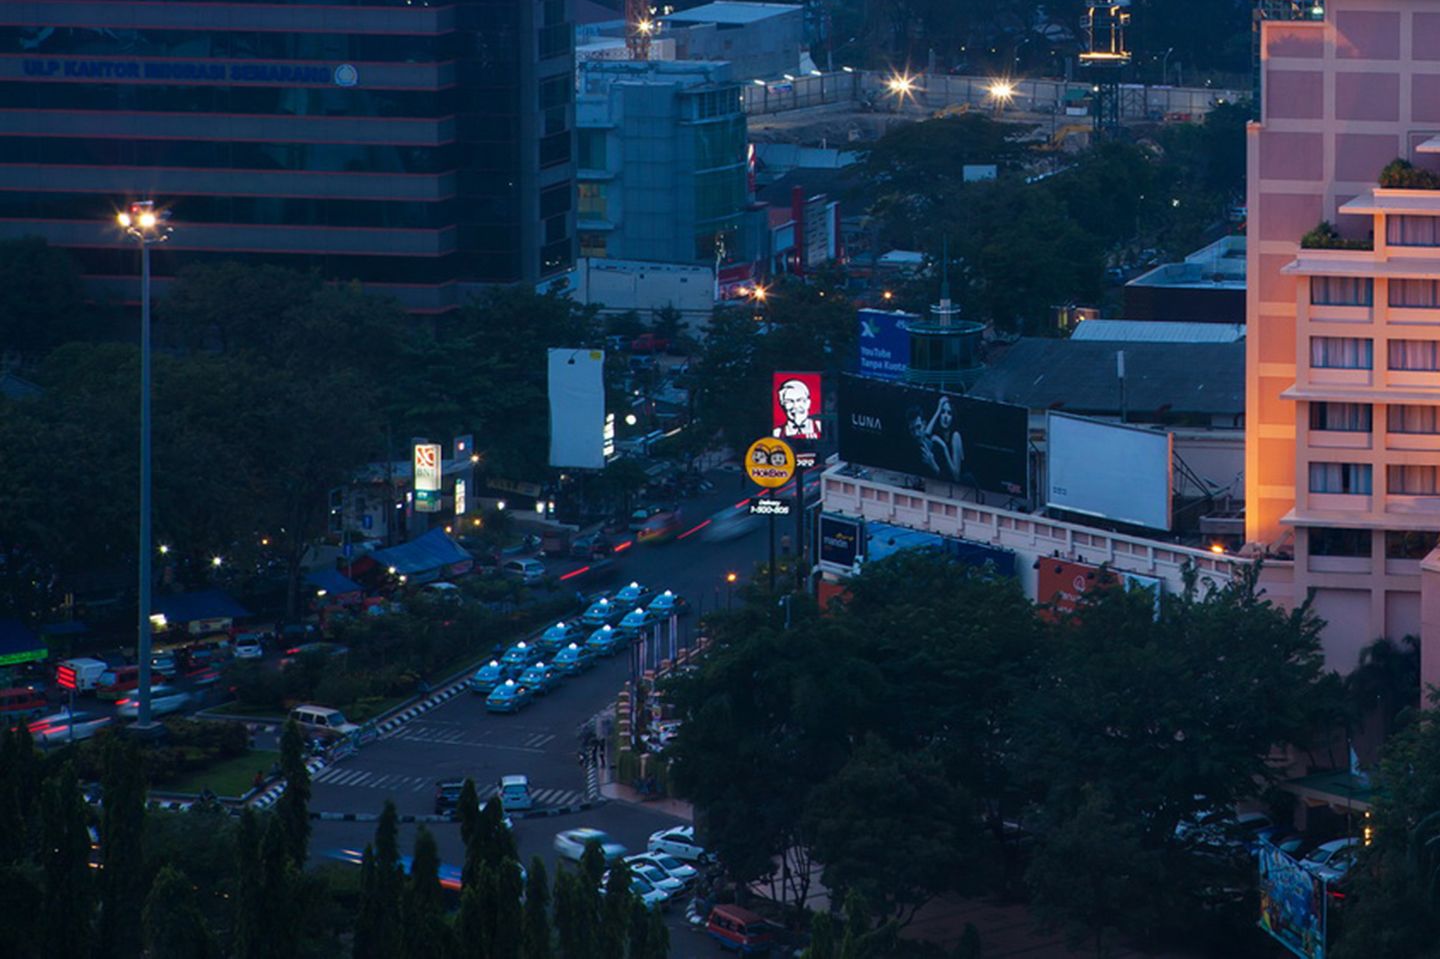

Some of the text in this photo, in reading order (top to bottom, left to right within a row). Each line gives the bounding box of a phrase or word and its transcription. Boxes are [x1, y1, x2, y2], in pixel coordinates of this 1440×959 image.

[24, 60, 60, 75] ULP
[64, 61, 140, 78] KANTOR
[230, 64, 331, 82] SEMARANG
[861, 346, 891, 359] YouTube
[861, 357, 907, 372] Tanpa Kuota
[852, 413, 882, 430] LUNA
[752, 467, 787, 477] HokBen
